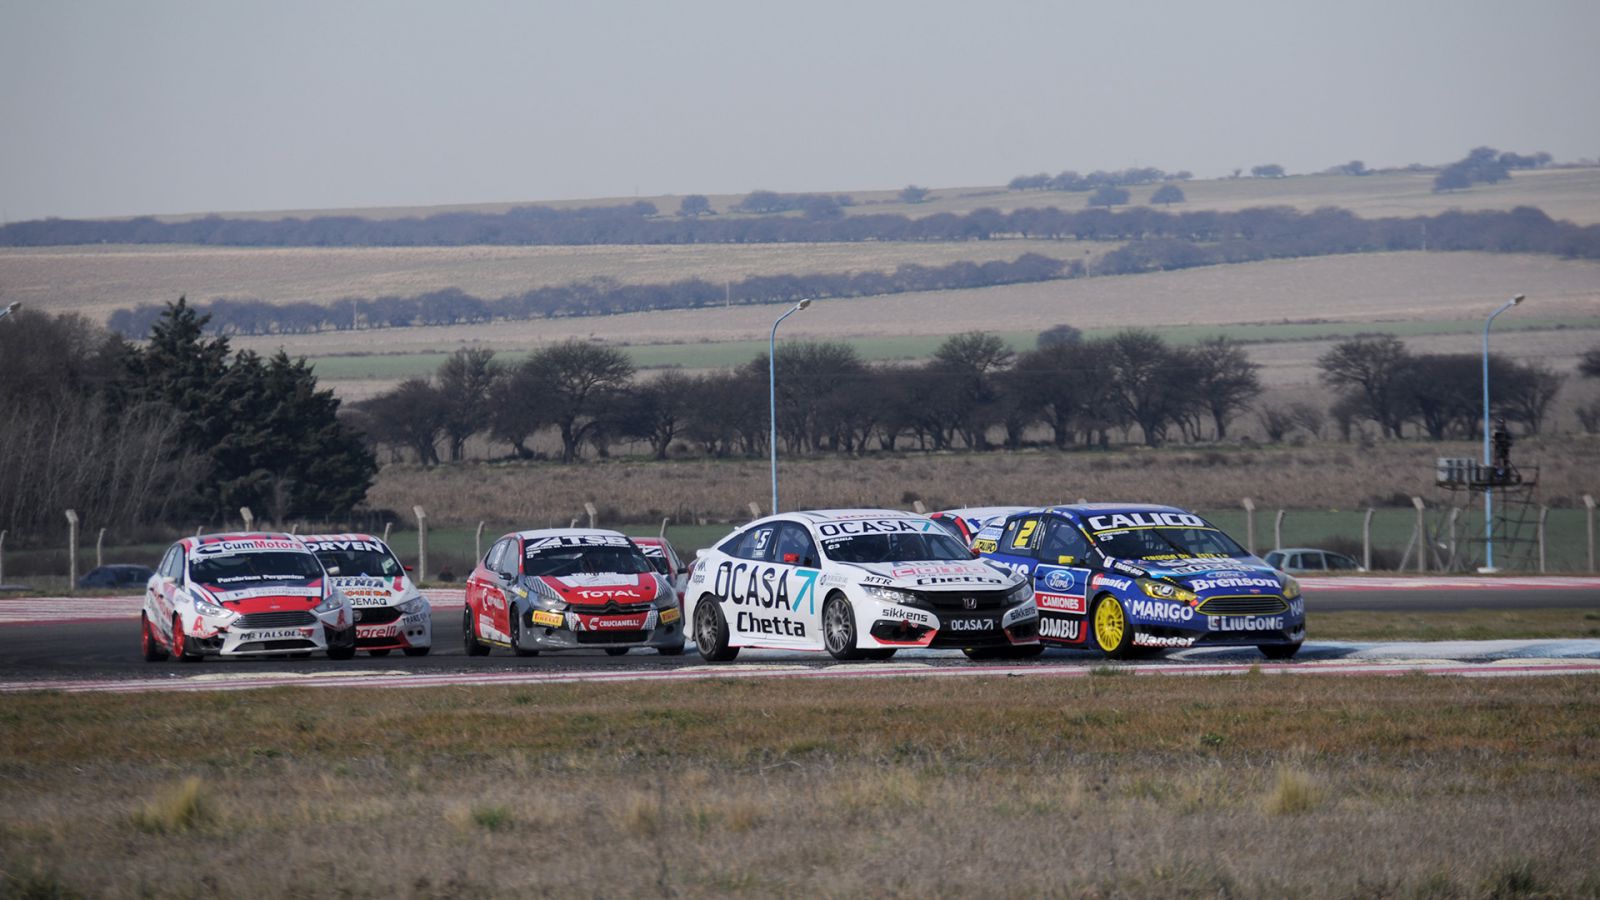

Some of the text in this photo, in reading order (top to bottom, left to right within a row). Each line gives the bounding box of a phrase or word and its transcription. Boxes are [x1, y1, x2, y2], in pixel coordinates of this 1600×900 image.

[820, 520, 918, 537] OCASA
[1088, 512, 1204, 531] CALICO
[757, 532, 769, 549] 5
[1014, 521, 1037, 546] 2
[223, 540, 303, 550] CumMotors
[715, 561, 791, 611] OCASA
[864, 575, 892, 586] MTR
[1048, 573, 1070, 588] Ford
[1188, 578, 1281, 593] Brenson
[577, 590, 640, 598] TOTAL
[1042, 596, 1079, 609] CAMIONES
[882, 608, 928, 622] sikkens
[1132, 600, 1194, 621] MARIGO
[737, 612, 806, 637] Chetta
[951, 620, 983, 631] OCASA
[1039, 617, 1079, 640] OMBU
[1134, 631, 1196, 646] Wander
